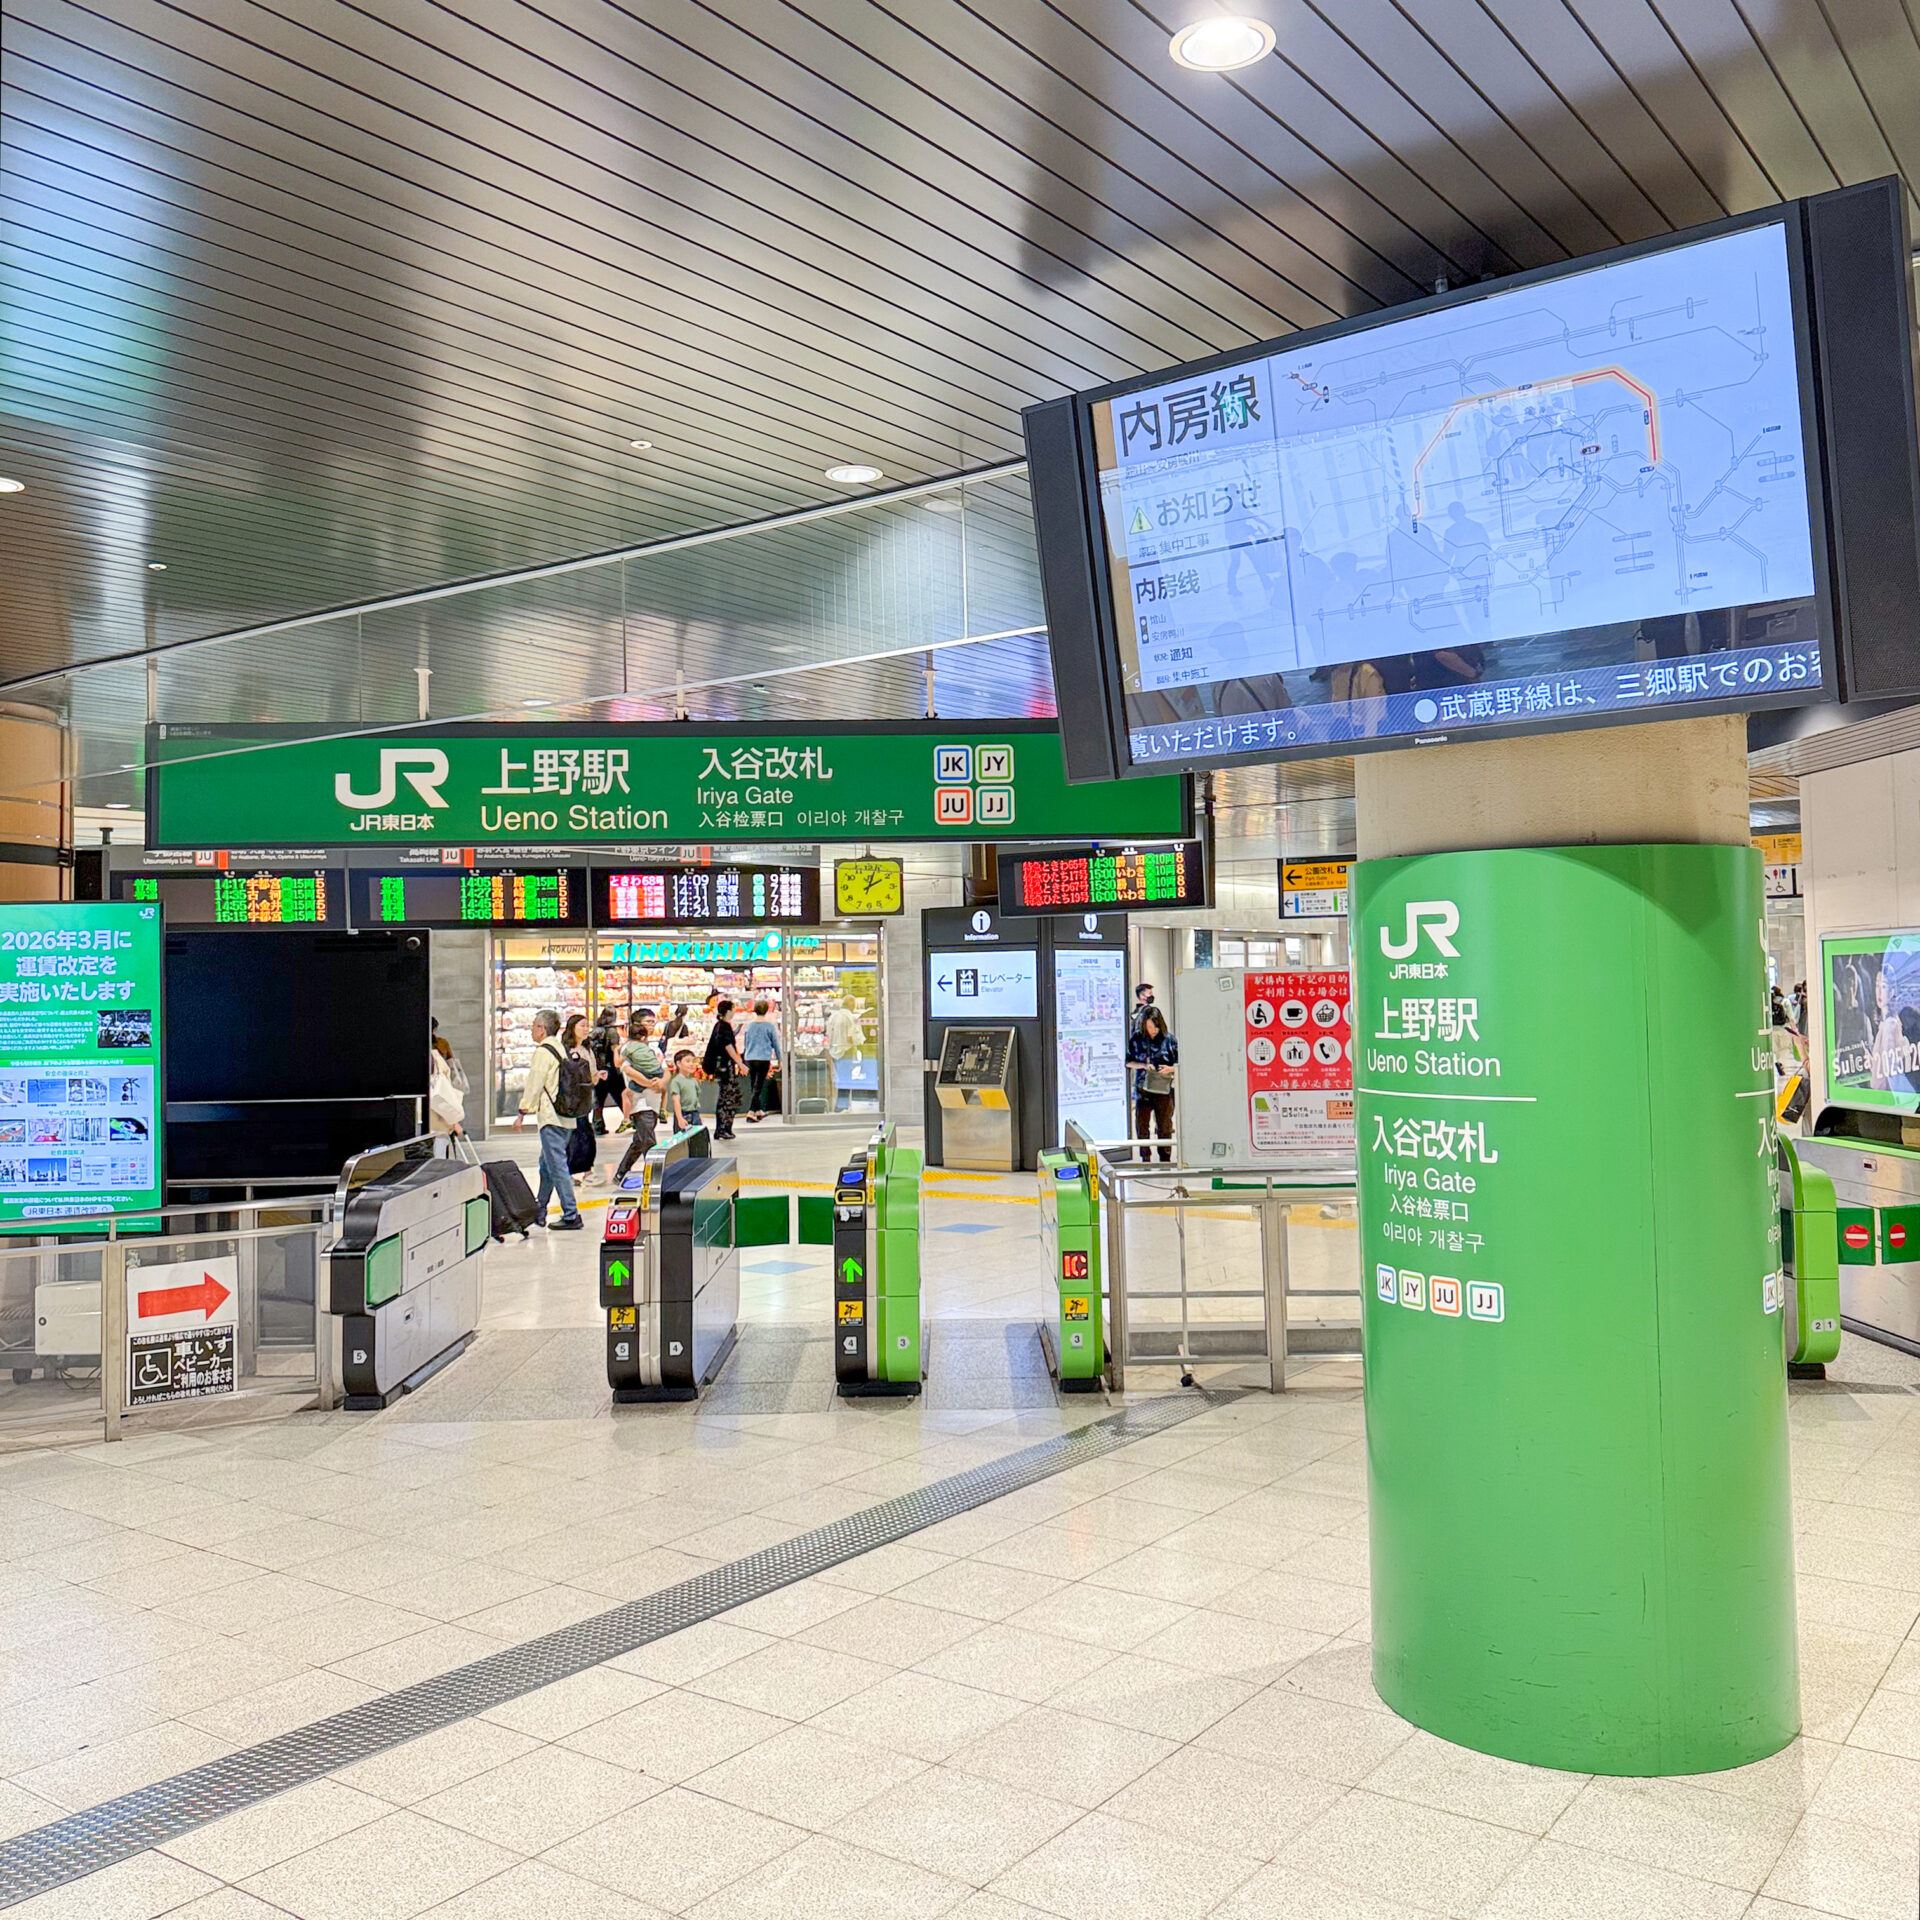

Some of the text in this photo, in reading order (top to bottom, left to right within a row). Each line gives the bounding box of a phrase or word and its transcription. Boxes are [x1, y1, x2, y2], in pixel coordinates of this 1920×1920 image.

[1120, 374, 1260, 457] 内房線
[1157, 480, 1261, 526] お知らせ
[1136, 569, 1200, 604] 内房线
[1170, 647, 1192, 662] 通知
[1414, 735, 1448, 745] Panasonic
[481, 748, 631, 795] 上野駅
[698, 746, 833, 780] 入谷改札
[942, 756, 1005, 772] JK JY
[335, 748, 450, 809] JR
[697, 786, 794, 808] Iriya Gate
[942, 798, 1003, 813] JU JJ
[350, 814, 435, 832] JR東日本
[481, 803, 668, 832] Ueno Station
[698, 811, 783, 828] 入谷检票口
[797, 809, 904, 826] 이리야 개찰구
[1089, 856, 1115, 869] 14:30
[1176, 852, 1184, 863] 8
[1089, 868, 1115, 879] 15:00
[1176, 864, 1184, 874] 8
[214, 878, 246, 889] 14:17
[316, 878, 325, 889] 5
[460, 877, 491, 888] 14:05
[558, 877, 567, 888] 5
[610, 875, 664, 886] ときわ68号
[672, 875, 709, 886] 14:09
[716, 875, 739, 886] 品川
[1090, 879, 1116, 891] 15:30
[1177, 876, 1185, 886] 8
[215, 889, 247, 900] 14:35
[316, 889, 325, 900] 5
[461, 888, 491, 898] 14:27
[559, 888, 567, 898] 5
[672, 886, 709, 897] 14:11
[1090, 890, 1117, 902] 16:00
[1177, 887, 1186, 897] 8
[215, 900, 247, 911] 14:55
[317, 900, 326, 911] 5
[461, 898, 492, 908] 14:45
[559, 898, 567, 908] 5
[672, 896, 709, 907] 14:21
[139, 908, 155, 917] JR
[216, 911, 248, 922] 15:15
[317, 911, 326, 922] 5
[462, 909, 492, 920] 15:05
[559, 909, 568, 920] 5
[673, 906, 710, 917] 14:24
[717, 906, 740, 917] 品川
[1380, 900, 1461, 959] JR
[2, 930, 132, 950] 2026年3月に
[612, 941, 768, 963] KINOKUNIYA
[16, 956, 117, 976] 運賃改定を
[1389, 962, 1448, 980] JR東日本
[981, 973, 1032, 984] エレベーター
[1254, 974, 1348, 985] 駅構内を下記の目的
[0, 981, 136, 1002] 実施いたします
[1256, 987, 1348, 997] ご利用される場合は
[1375, 997, 1480, 1042] 上野駅
[1368, 1048, 1501, 1076] Ueno Station
[1271, 1080, 1352, 1088] 入場券が必要です
[1372, 1115, 1498, 1164] 入谷改札
[1384, 1162, 1476, 1193] Iriya Gate
[1389, 1194, 1469, 1222] 入谷检票口
[610, 1224, 626, 1234] QR
[1383, 1222, 1485, 1254] 이리야 개찰구
[1064, 1254, 1087, 1277] IC
[1405, 1282, 1418, 1298] JY
[1437, 1288, 1453, 1304] JU
[1477, 1294, 1492, 1309] JJ
[174, 1336, 232, 1357] 車いす
[174, 1354, 232, 1372] ベビーカー
[174, 1366, 232, 1388] ご利用のお客さま
